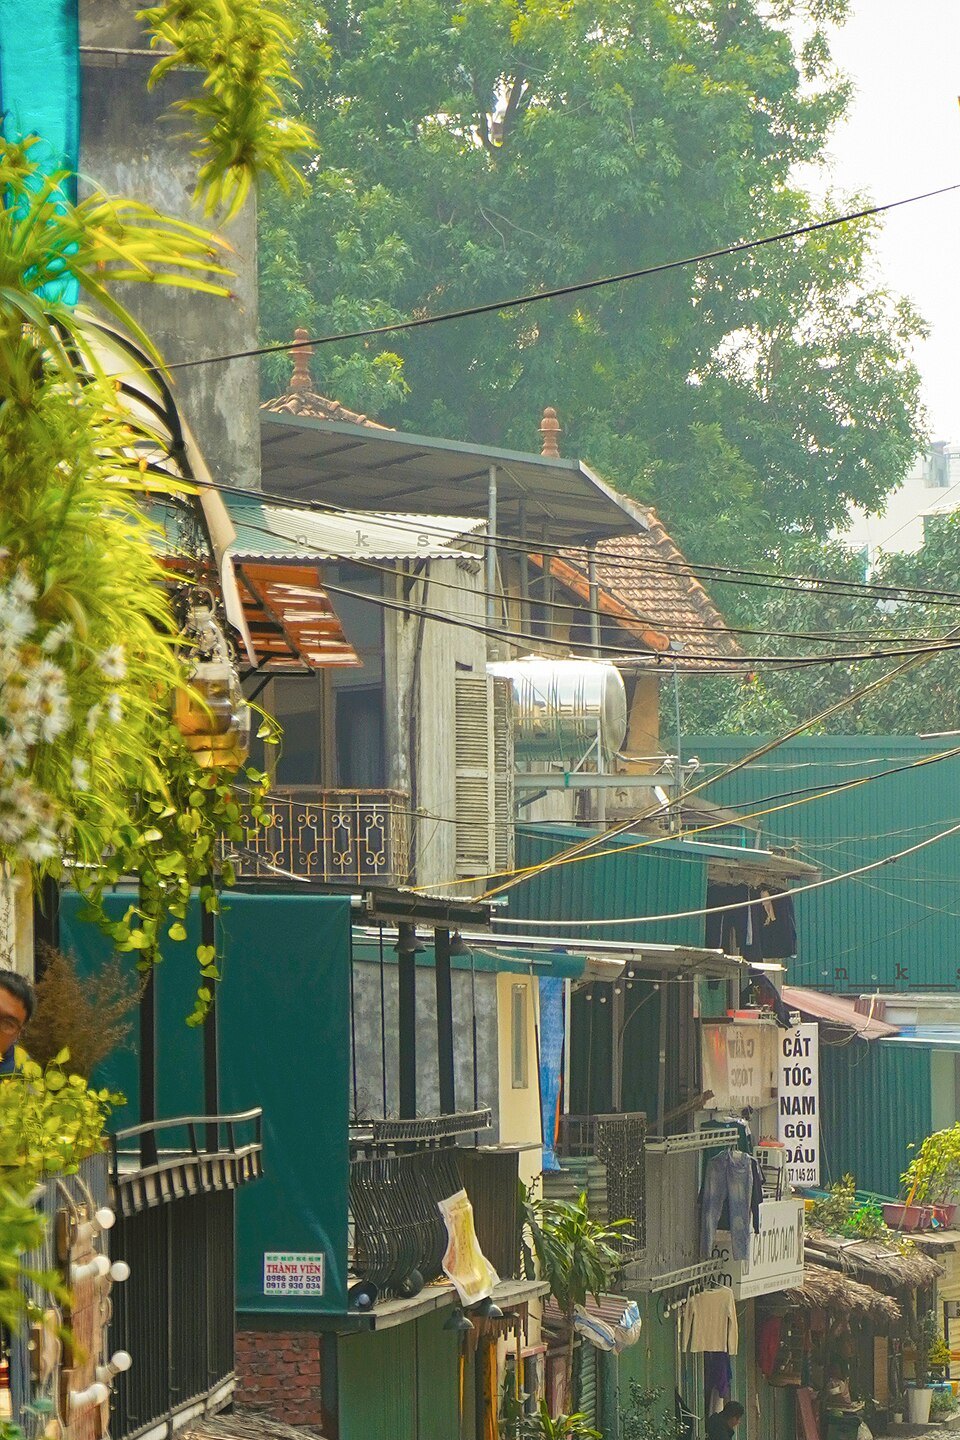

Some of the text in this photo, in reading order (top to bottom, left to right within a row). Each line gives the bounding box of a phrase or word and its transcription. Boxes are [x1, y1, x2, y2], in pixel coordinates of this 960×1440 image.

[782, 1030, 811, 1057] CẮT
[783, 1063, 812, 1086] TÓC
[780, 1096, 816, 1115] NAM
[784, 1120, 812, 1141] GỘI
